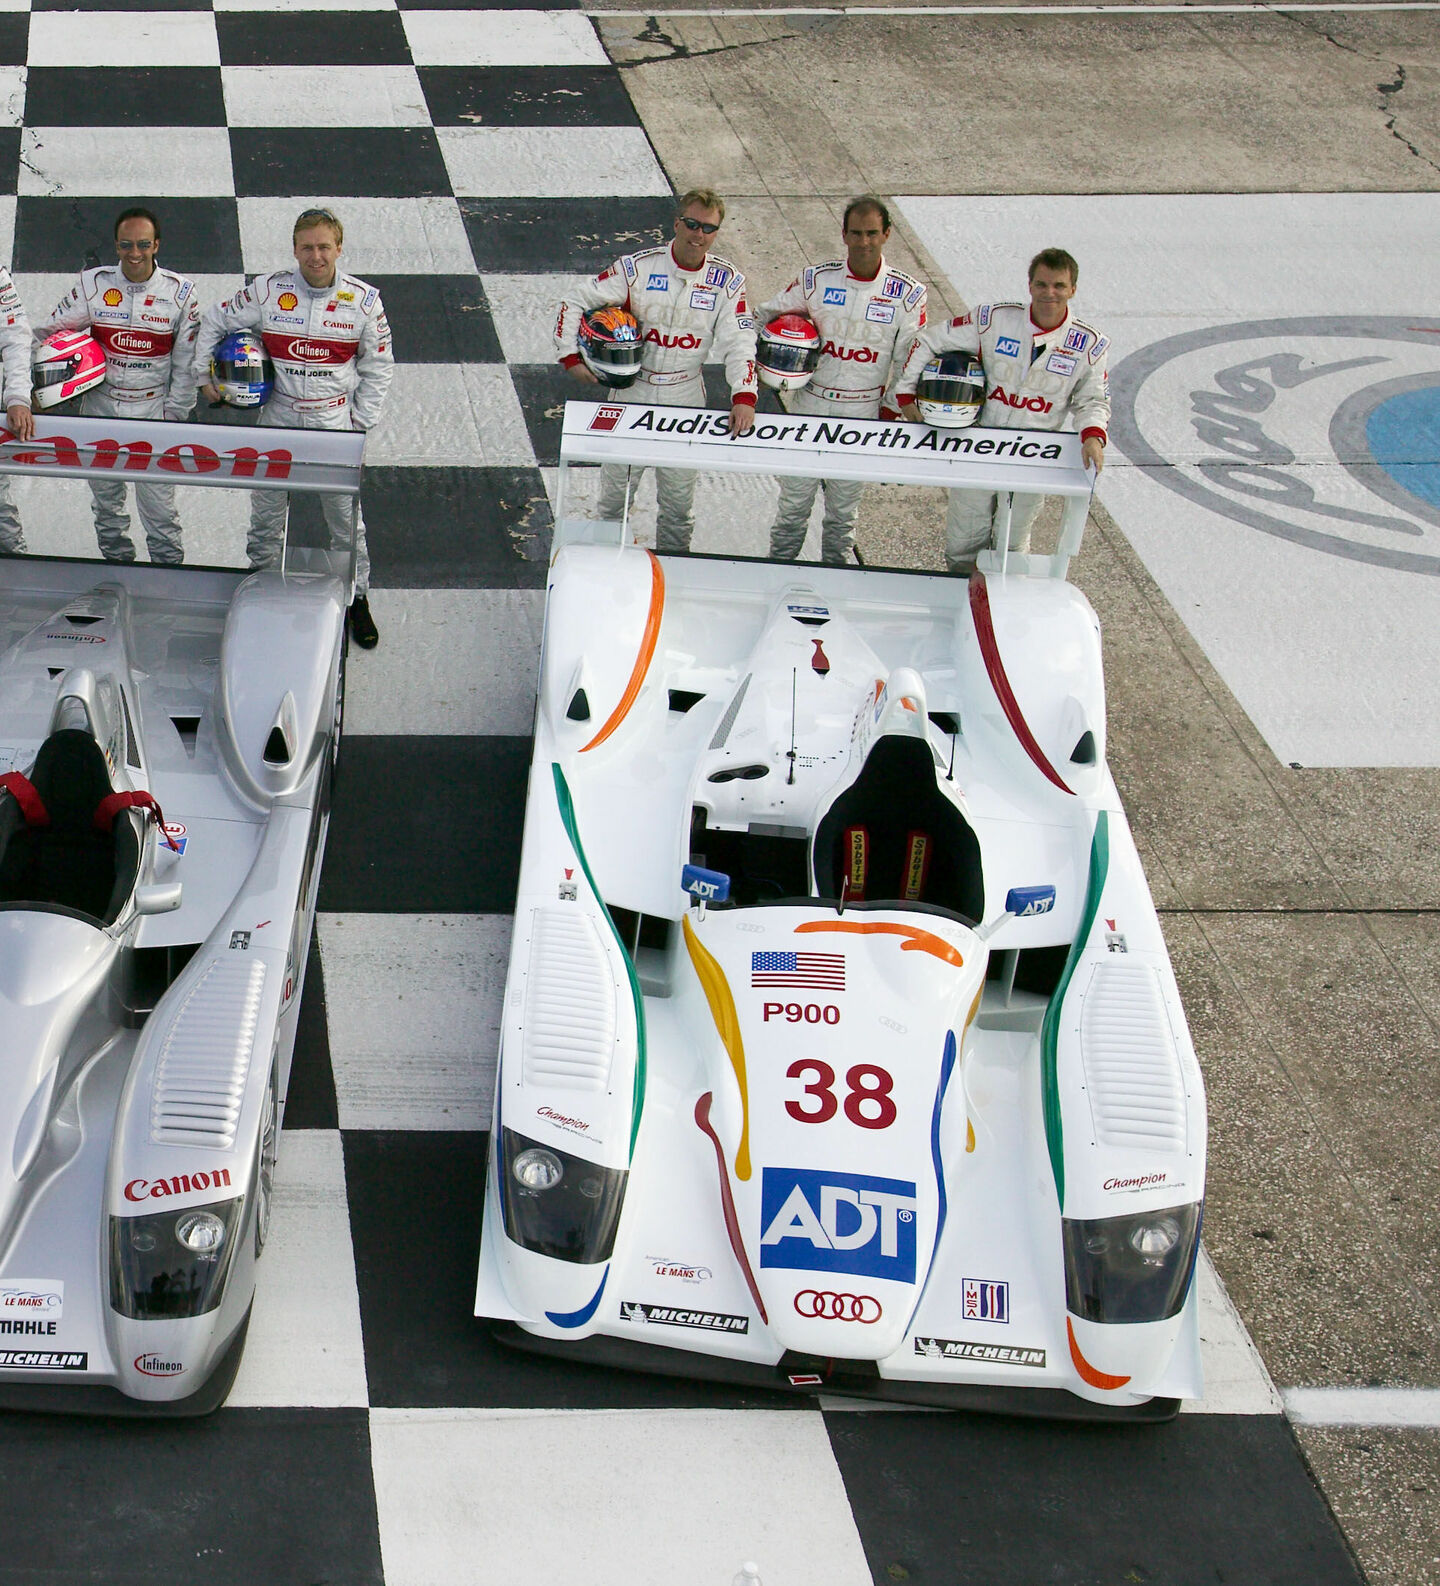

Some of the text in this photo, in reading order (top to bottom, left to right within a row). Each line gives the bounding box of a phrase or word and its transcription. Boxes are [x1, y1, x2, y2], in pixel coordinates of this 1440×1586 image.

[647, 276, 667, 290] ADT
[825, 290, 845, 303] ADT
[141, 314, 170, 324] Canon
[323, 320, 354, 330] Canon
[644, 328, 703, 349] Audi
[996, 341, 1019, 355] ADT
[820, 340, 879, 363] Audi
[109, 358, 127, 368] TEAM
[285, 368, 306, 376] TEAM
[988, 385, 1054, 414] Audi
[812, 422, 910, 450] North
[913, 430, 1062, 461] America
[688, 879, 720, 899] ADT
[1020, 896, 1054, 916] ADT
[763, 1002, 841, 1025] P900
[784, 1058, 898, 1130] 38
[536, 1105, 591, 1132] Champion
[123, 1167, 233, 1203] Canon
[1103, 1172, 1167, 1191] Champion
[656, 1267, 695, 1278] LE MANS
[5, 1297, 44, 1307] LE MANS
[966, 1282, 977, 1317] IMSA
[649, 1307, 747, 1330] MICHELIN
[944, 1342, 1044, 1363] MICHELIN
